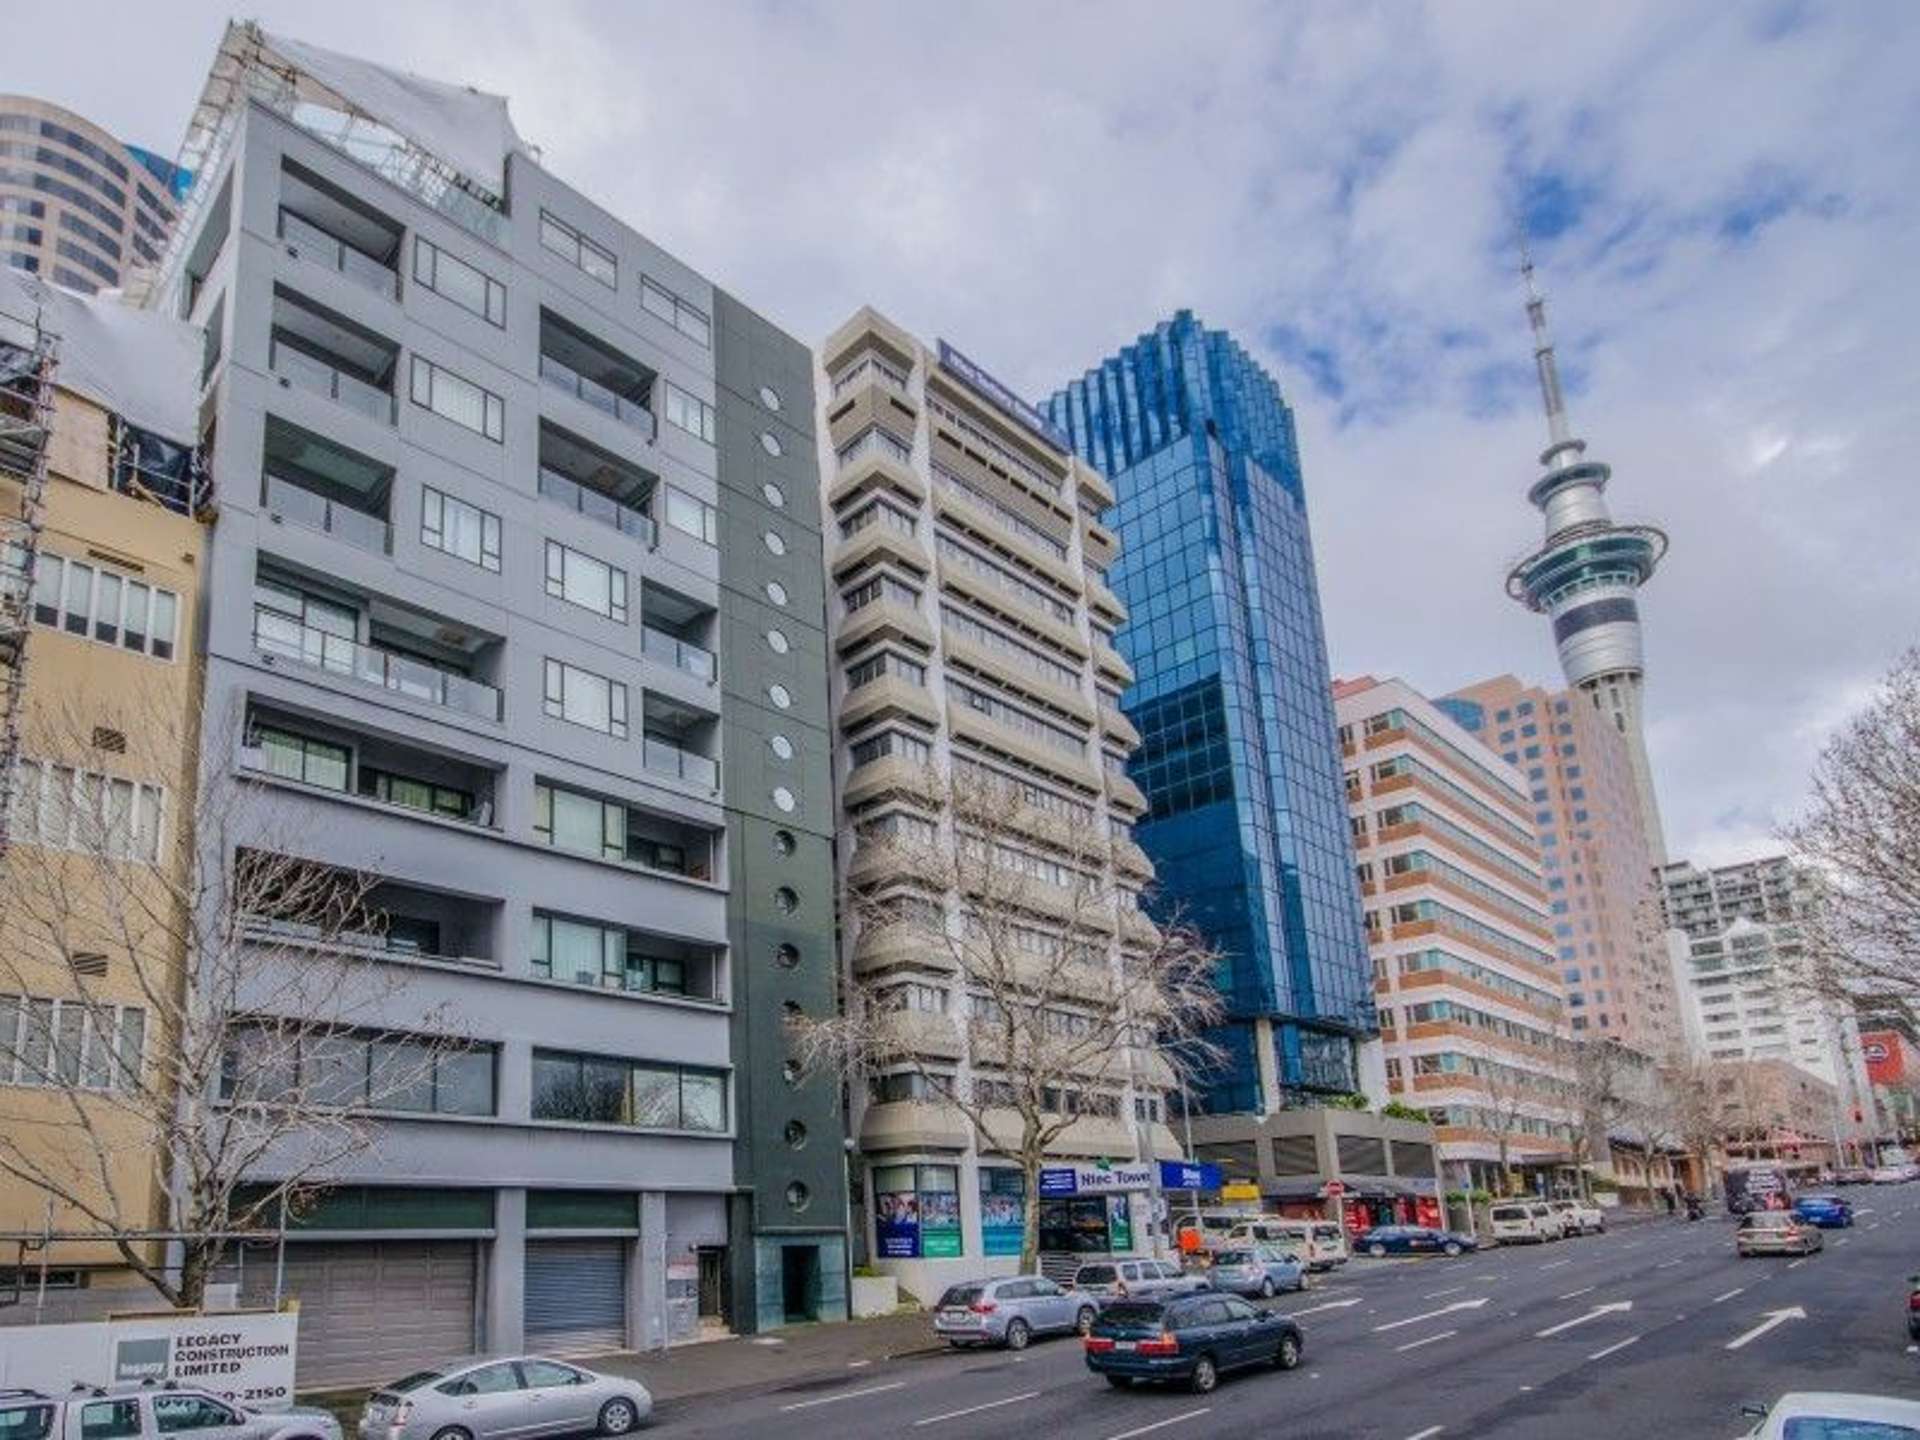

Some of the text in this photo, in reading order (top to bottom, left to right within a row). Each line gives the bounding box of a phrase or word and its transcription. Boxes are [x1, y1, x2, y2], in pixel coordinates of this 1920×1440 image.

[177, 1333, 242, 1348] LEGACY
[174, 1344, 290, 1362] CONSTRUCTION
[174, 1362, 242, 1378] LIMITED
